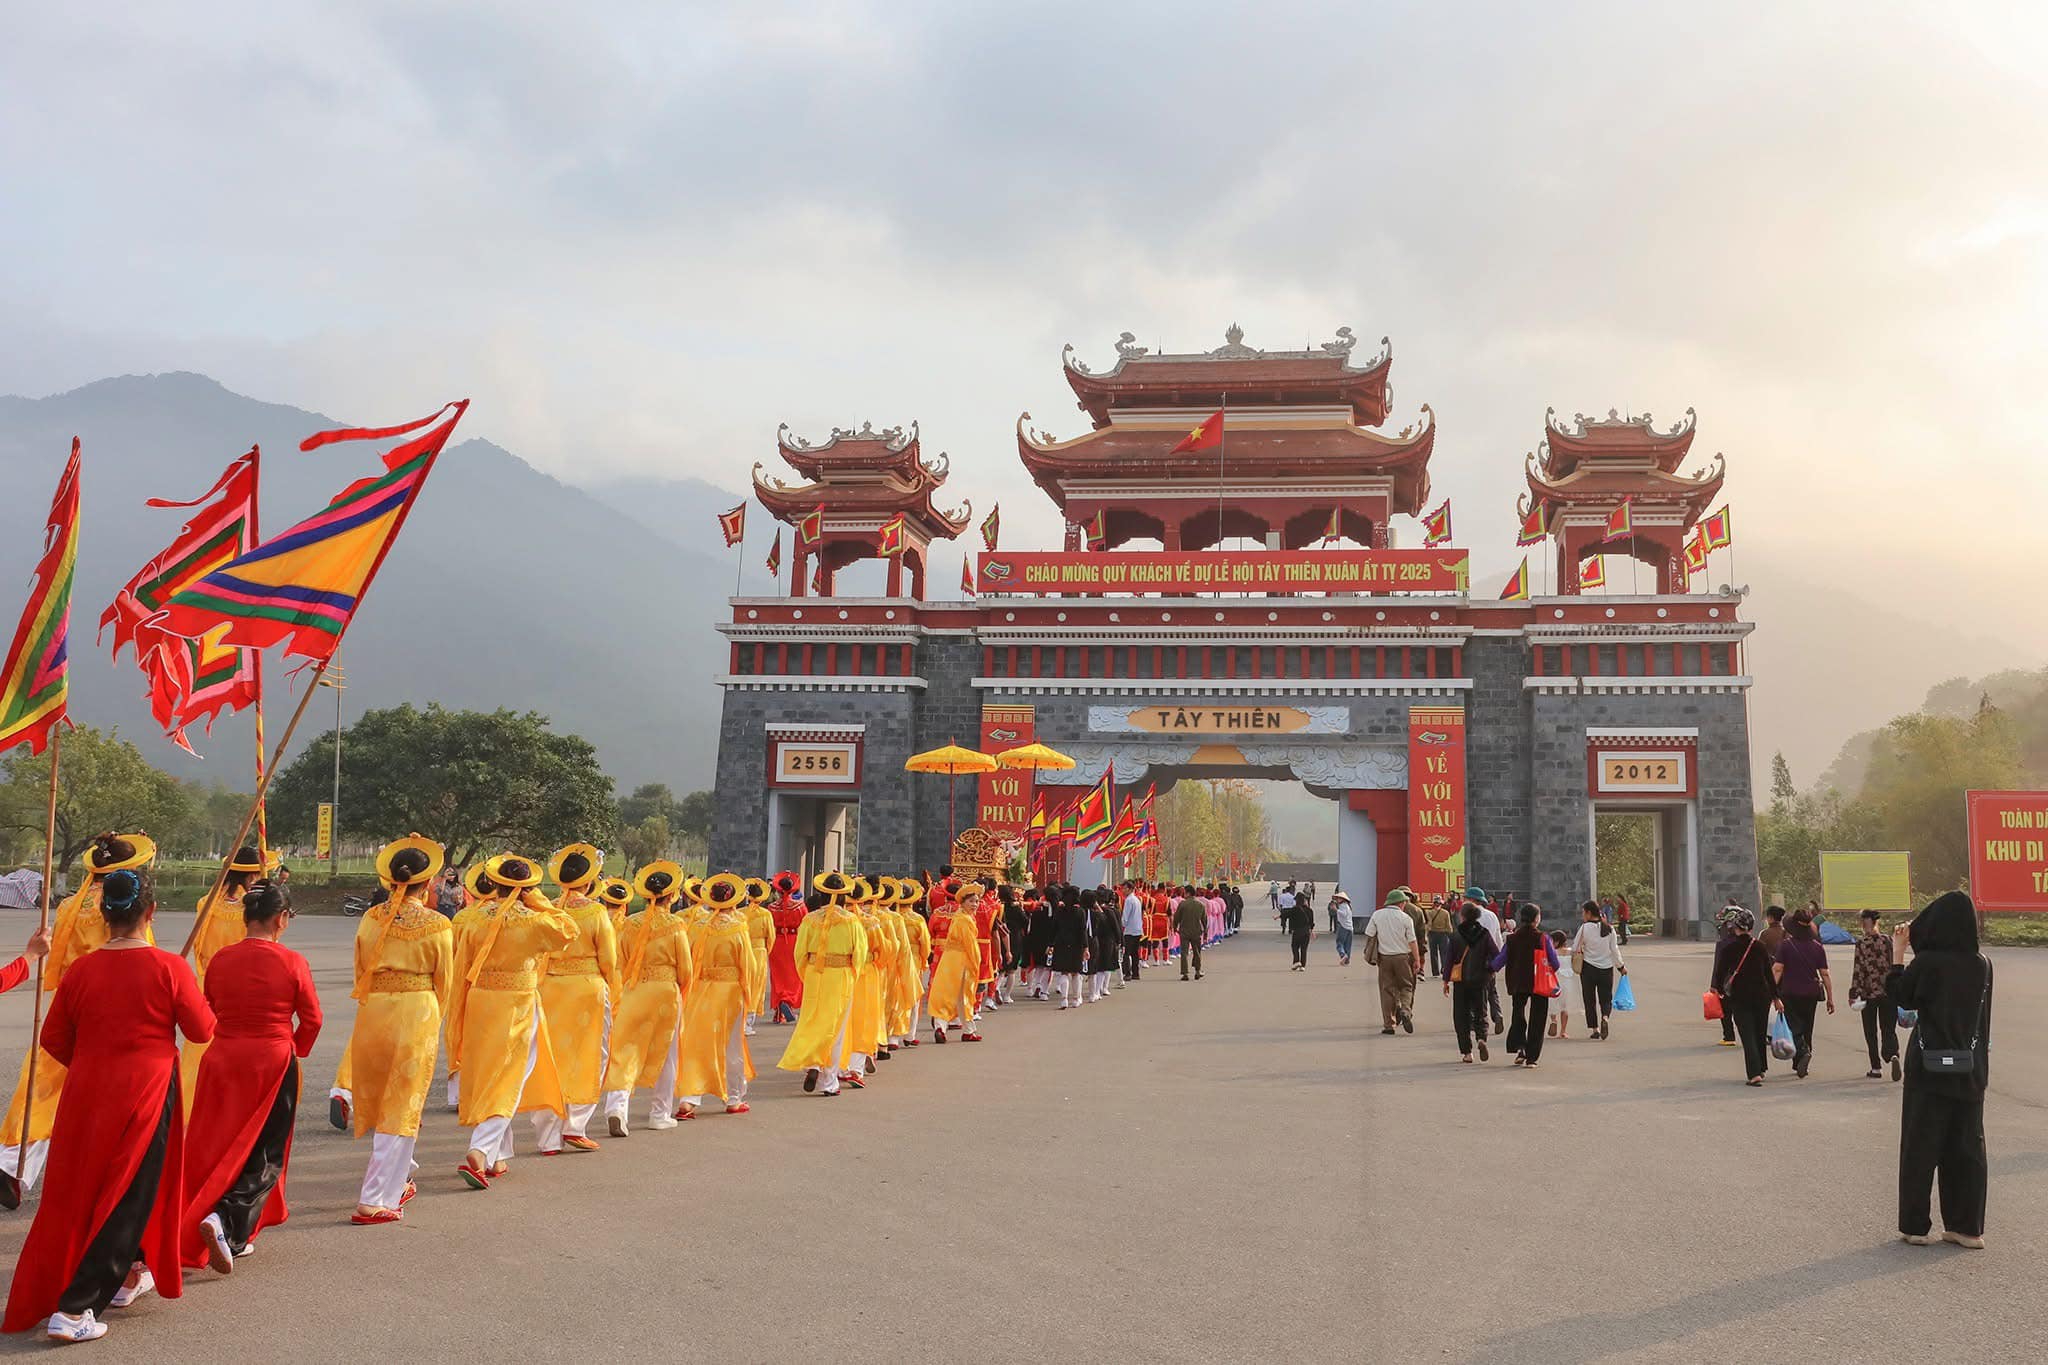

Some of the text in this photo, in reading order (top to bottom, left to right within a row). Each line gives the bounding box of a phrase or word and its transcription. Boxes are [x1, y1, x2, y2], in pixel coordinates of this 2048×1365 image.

[1026, 558, 1432, 585] CHÀO MỪNG QUÝ KHÁCH VỀ DỰ LỄ HỘI TÂY THIÊN XUÂN ẤT TỴ 2025
[1158, 707, 1281, 728] TÂY THIÊN
[791, 756, 841, 770] 2556
[1425, 752, 1448, 774] VỀ
[1614, 764, 1666, 779] 2012
[992, 776, 1019, 796] VỚI
[1423, 779, 1451, 801] VỚI
[982, 802, 1026, 825] PHẬT
[1419, 804, 1455, 827] MẪU
[1999, 808, 2033, 828] TOÀN
[1986, 840, 2044, 862] KHU DI
